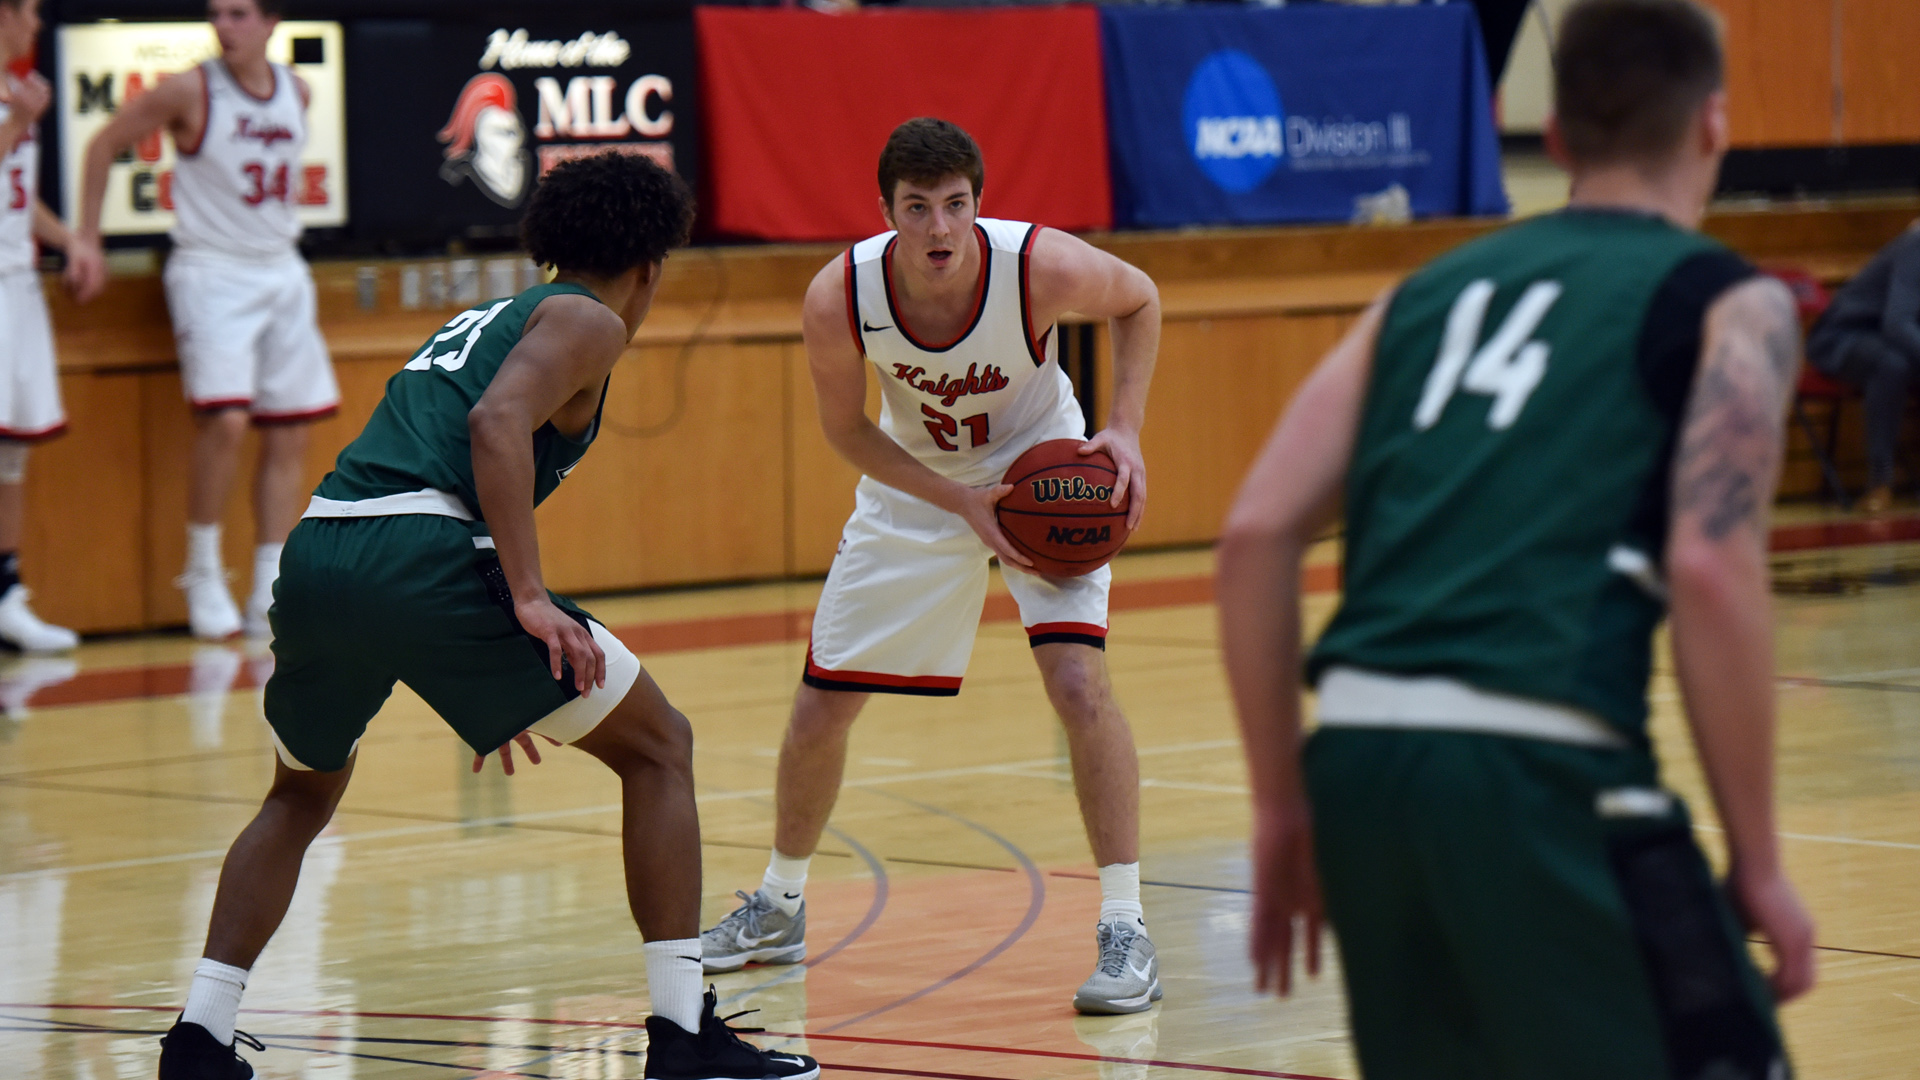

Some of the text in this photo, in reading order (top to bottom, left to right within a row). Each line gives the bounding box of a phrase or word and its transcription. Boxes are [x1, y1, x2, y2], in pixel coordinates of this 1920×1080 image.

[533, 74, 674, 138] MLC
[242, 162, 289, 207] 34
[403, 298, 514, 372] 23
[1412, 278, 1564, 431] 14
[890, 362, 1010, 407] Knights
[921, 403, 990, 451] 21
[1031, 475, 1114, 504] Wilso
[1045, 525, 1111, 546] NCAA
